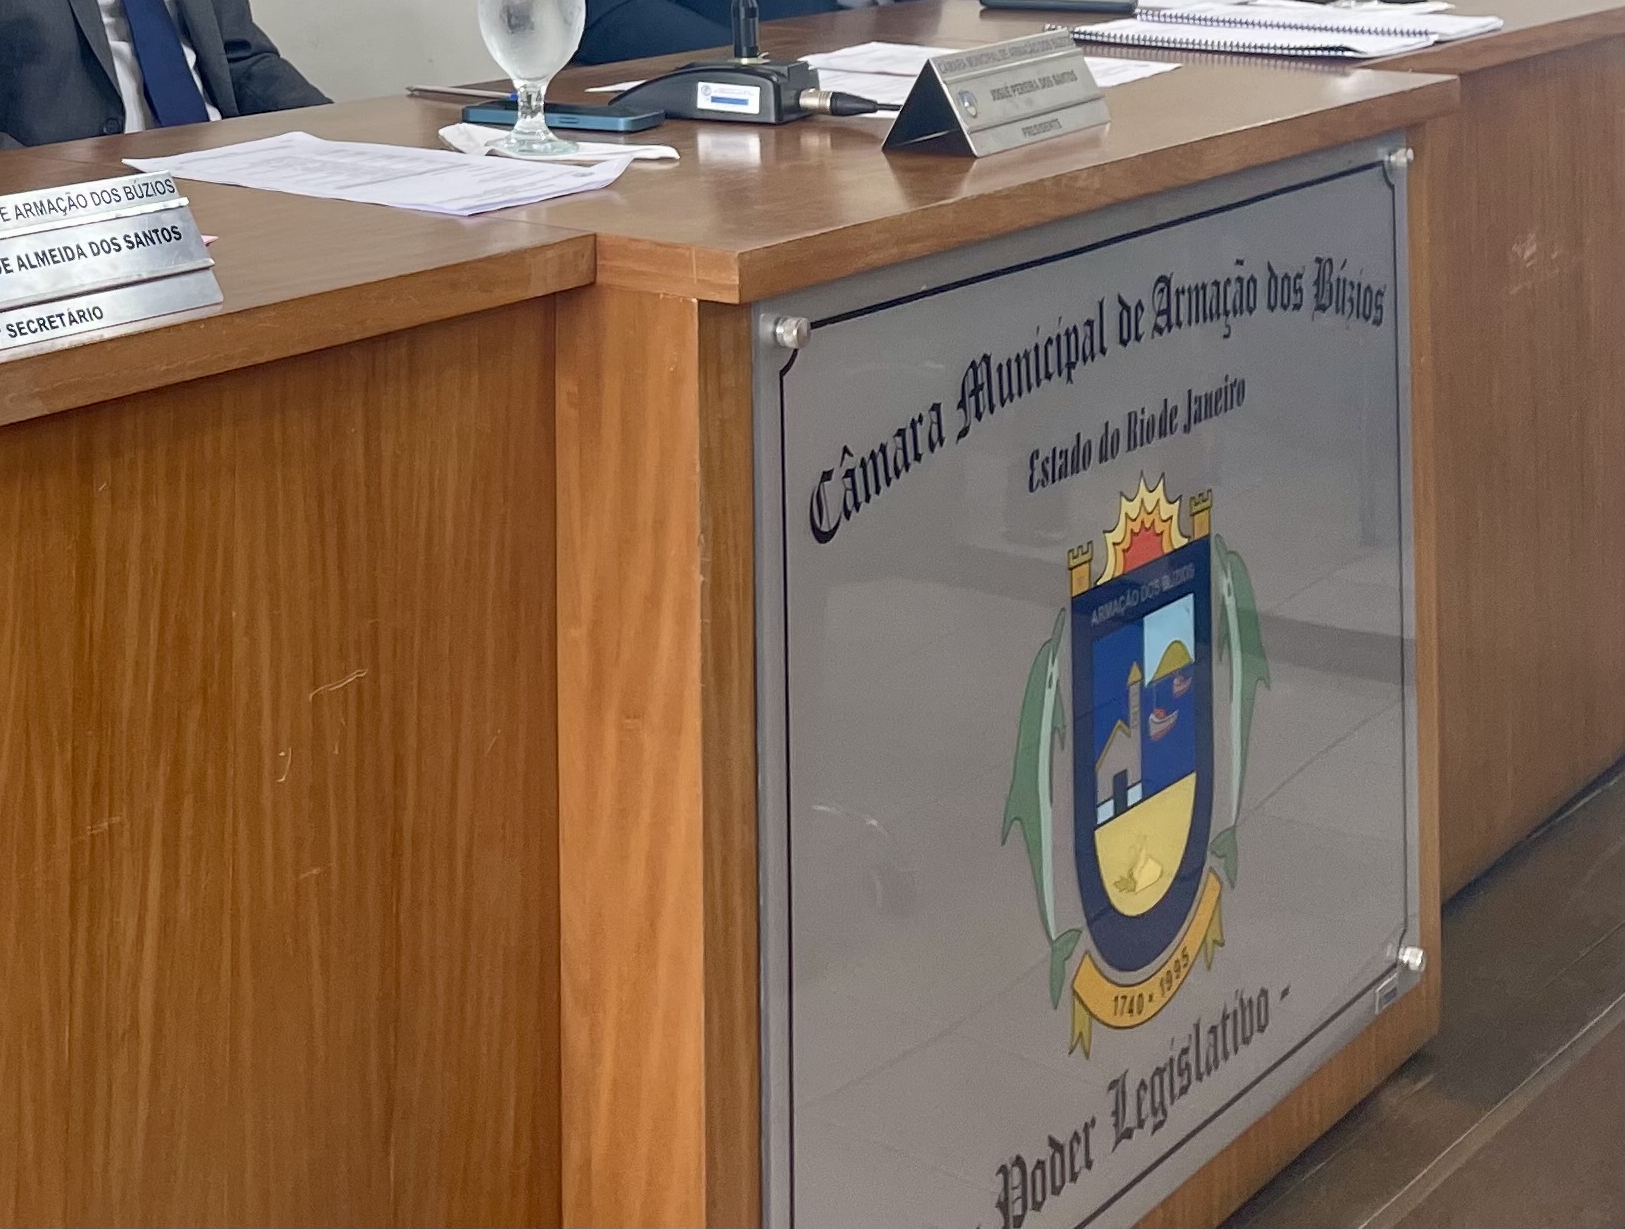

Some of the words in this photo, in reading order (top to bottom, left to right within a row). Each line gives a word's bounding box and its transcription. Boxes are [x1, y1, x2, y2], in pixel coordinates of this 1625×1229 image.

[14, 190, 89, 221] ARMAÇÃO
[92, 186, 123, 208] DOS
[125, 177, 176, 202] BÚZIOS
[17, 245, 88, 273] ALMEIDA
[90, 236, 122, 258] DOS
[125, 225, 182, 250] SANTOS
[5, 305, 104, 340] SECRETÁRIO
[809, 399, 945, 544] Câmara
[956, 298, 1107, 444] Municipal
[1118, 293, 1145, 348] de
[1151, 261, 1257, 338] Armação
[1265, 261, 1304, 312] dos
[1312, 257, 1387, 328] Búzios
[1027, 434, 1092, 494] Estado
[1098, 425, 1120, 463] do
[1126, 409, 1155, 454] Rio
[1183, 374, 1246, 435] Janeiro
[995, 1115, 1096, 1229] Poder
[1107, 986, 1270, 1153] Legislativo
